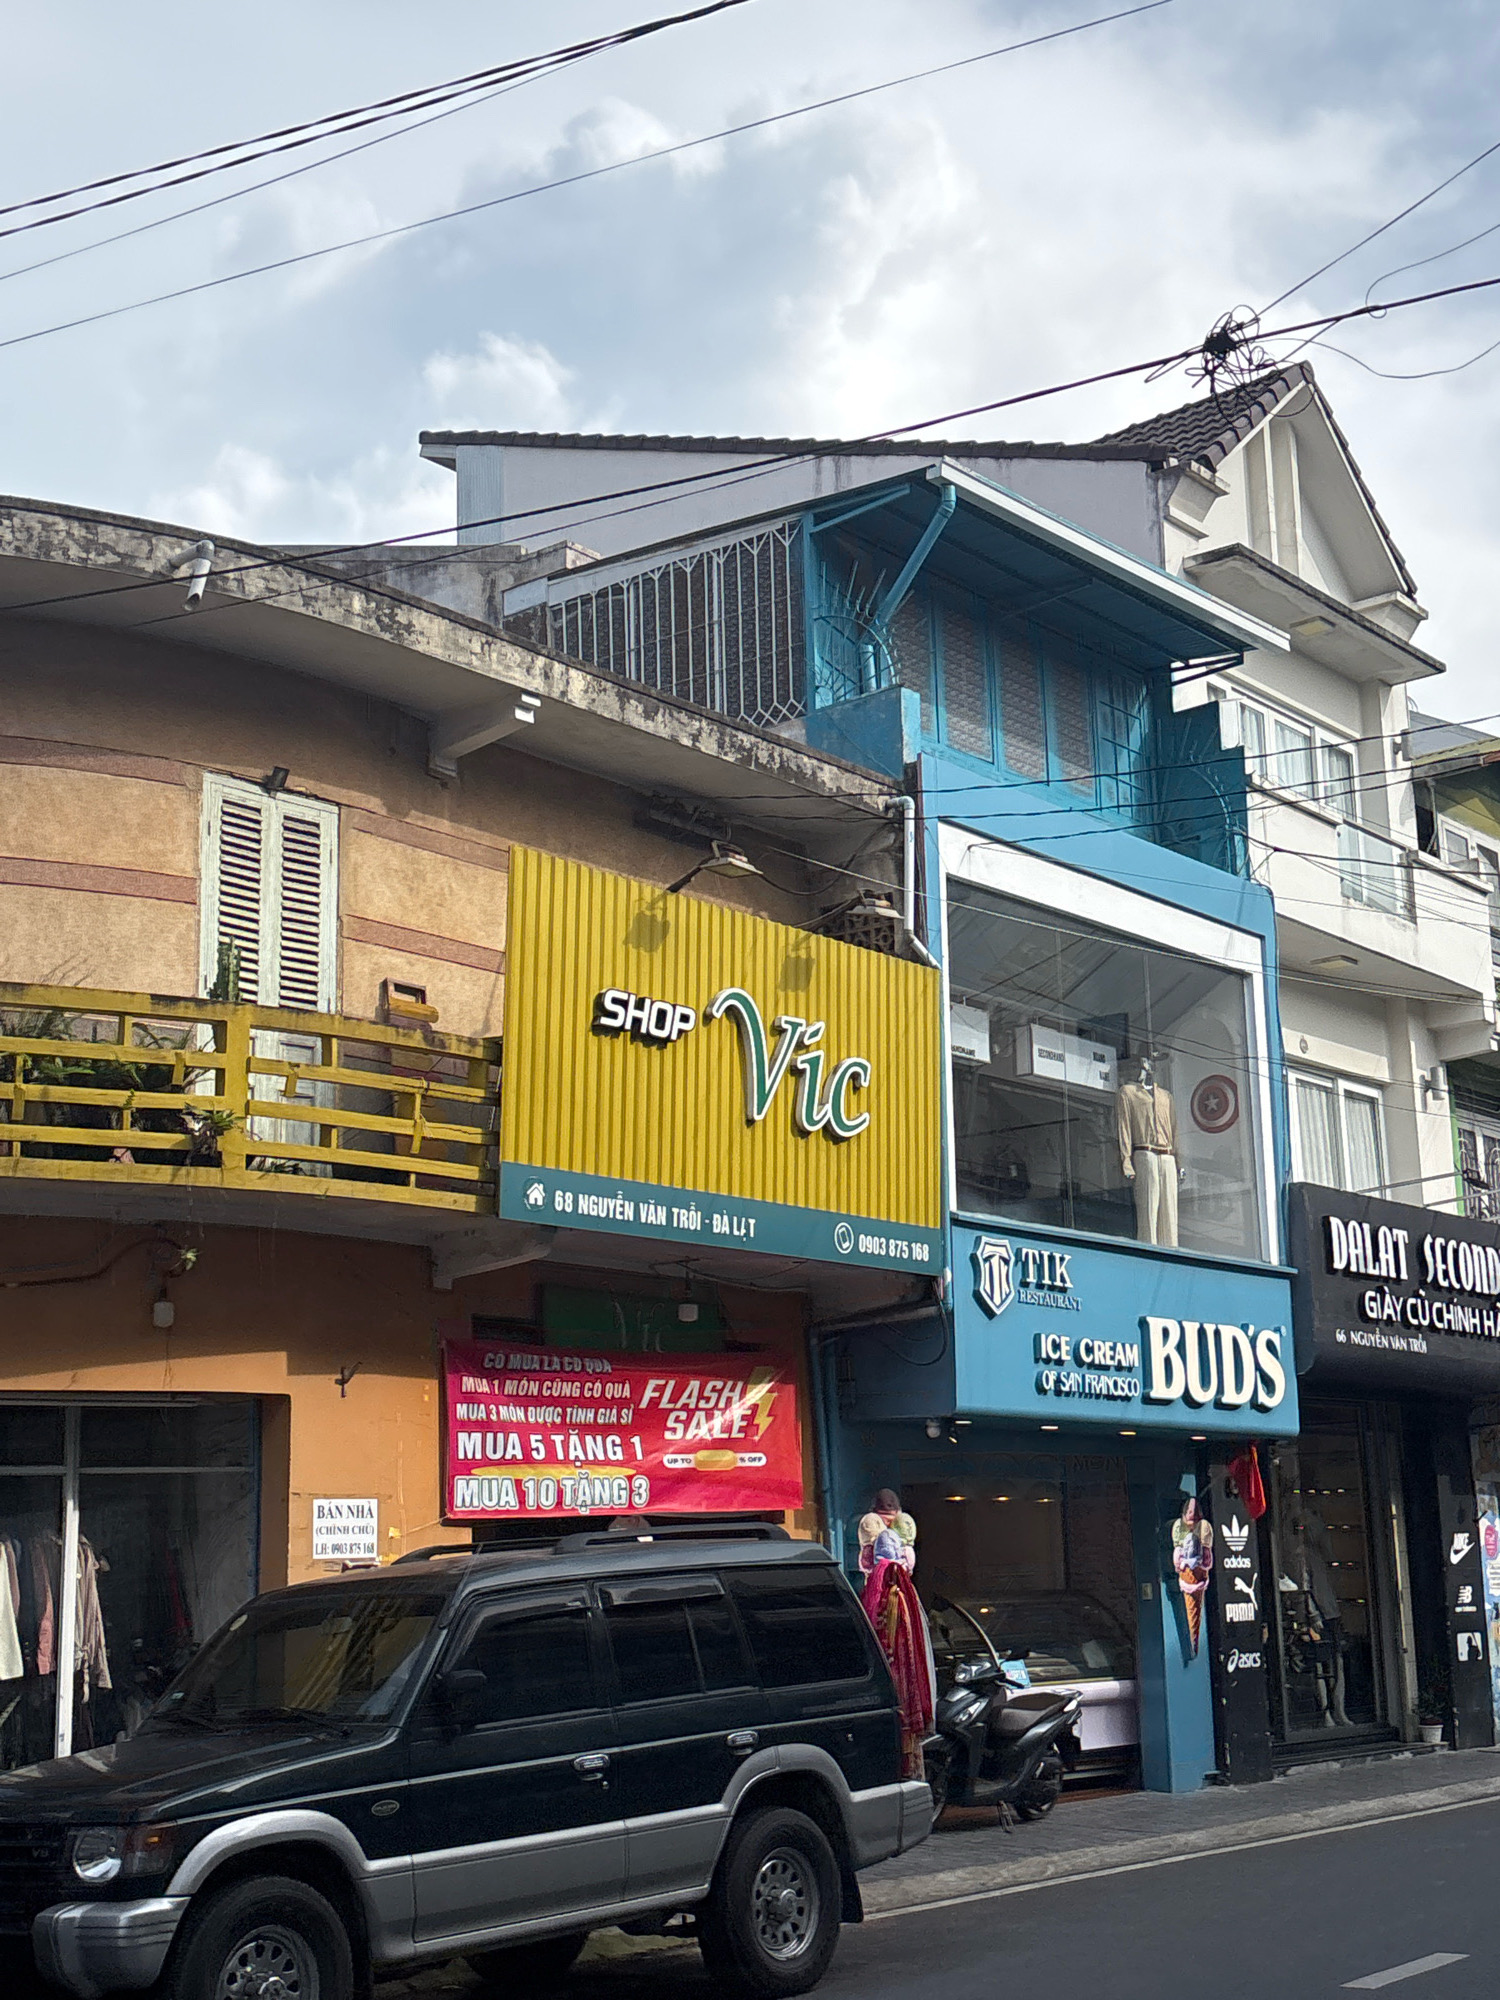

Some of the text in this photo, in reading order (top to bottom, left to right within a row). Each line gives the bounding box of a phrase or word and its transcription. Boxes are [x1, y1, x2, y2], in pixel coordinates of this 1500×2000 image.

[600, 988, 697, 1042] SHOP
[554, 1190, 573, 1213] 68
[578, 1191, 634, 1221] NGUYỄN
[639, 1199, 667, 1226] VĂN
[671, 1202, 702, 1231] TRỖI
[712, 1210, 730, 1235] ĐÀ
[858, 1234, 930, 1262] 0903 875 168
[1329, 1216, 1409, 1280] DALAT
[1021, 1247, 1074, 1288] TIK
[1019, 1289, 1083, 1312] RESTAURANT
[1364, 1286, 1403, 1322] GIÀY
[1432, 1298, 1481, 1334] CHÍNH
[1041, 1333, 1139, 1368] ICE CREAM
[1336, 1329, 1347, 1344] 66
[1145, 1316, 1287, 1409] BUD'S
[461, 1376, 631, 1399] MUA 1 MÓN CŨNG CÓ QUÀ
[638, 1379, 744, 1409] FLASH
[1042, 1370, 1140, 1397] OF SAN FRANCISCO
[456, 1403, 487, 1421] MUA
[489, 1404, 497, 1422] 3
[499, 1403, 527, 1423] MÓN
[527, 1405, 562, 1427] ĐƯỢC
[664, 1410, 752, 1440] SALE
[457, 1429, 644, 1467] MUA 5 TẶNG 1
[455, 1471, 650, 1513] MUA 10 TẶNG 3
[317, 1500, 374, 1519] BÁN NHÀ
[315, 1543, 375, 1556] LH: 0903 875 168
[1224, 1554, 1252, 1569] adidas
[1225, 1603, 1255, 1623] PUMA
